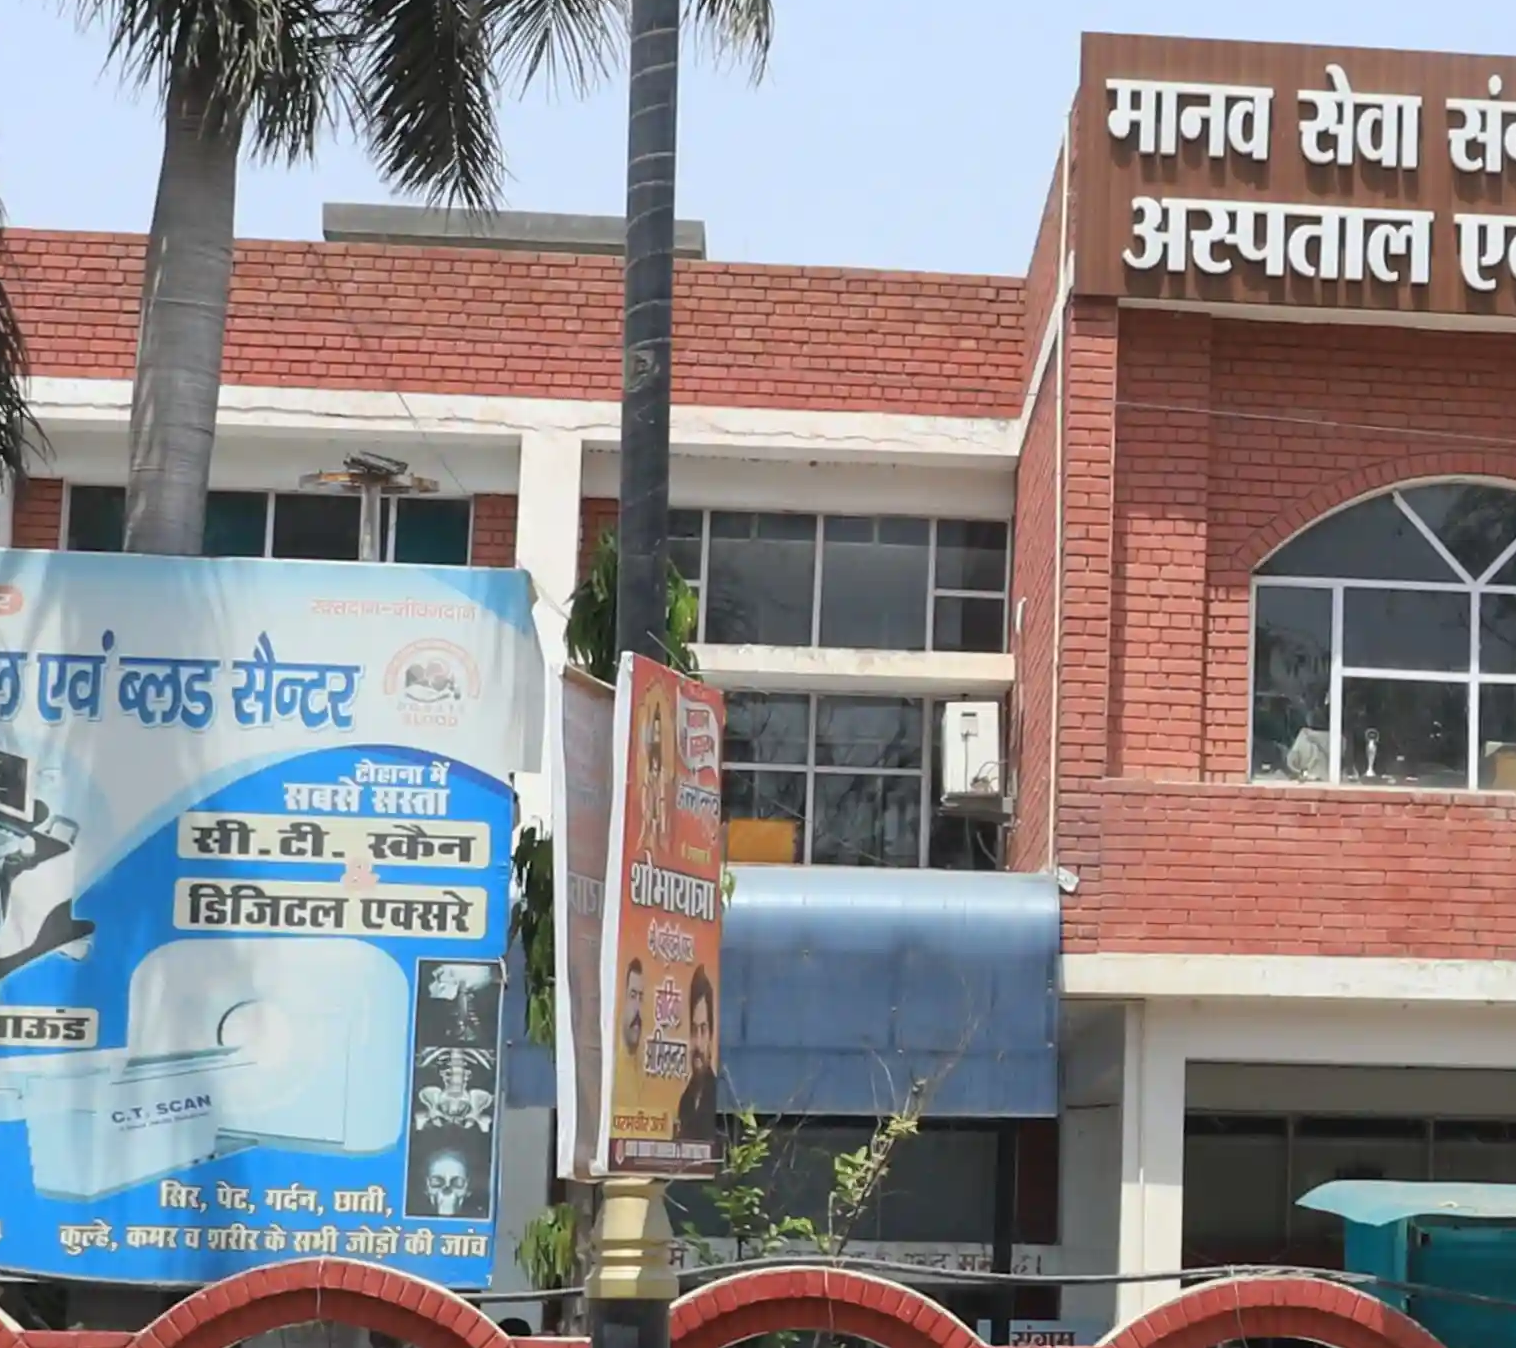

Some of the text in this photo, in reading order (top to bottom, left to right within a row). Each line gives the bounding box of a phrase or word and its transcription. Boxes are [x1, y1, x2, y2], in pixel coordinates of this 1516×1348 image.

[1106, 78, 1274, 160] मानव
[1298, 64, 1421, 169] सेवा
[1123, 196, 1433, 284] अस्पताल
[37, 630, 115, 722] एवं
[119, 655, 220, 728] ब्लड
[232, 631, 361, 729] सैन्टर
[355, 759, 451, 785] टोहाना में
[284, 776, 450, 816] सबसे सस्ता
[367, 824, 477, 862] स्कैन
[630, 851, 715, 921] शोभायात्रा
[189, 883, 474, 932] डिजिटल एक्सरे
[156, 1095, 211, 1114] SCAN
[160, 1181, 207, 1213] सिर,
[217, 1182, 256, 1214] पेट,
[127, 1225, 176, 1248] कमर
[184, 1226, 203, 1249] व
[207, 1225, 260, 1250] शरीर
[264, 1221, 287, 1251] के
[293, 1225, 339, 1252] सभी
[405, 1228, 433, 1255] की
[441, 1228, 488, 1257] जांच
